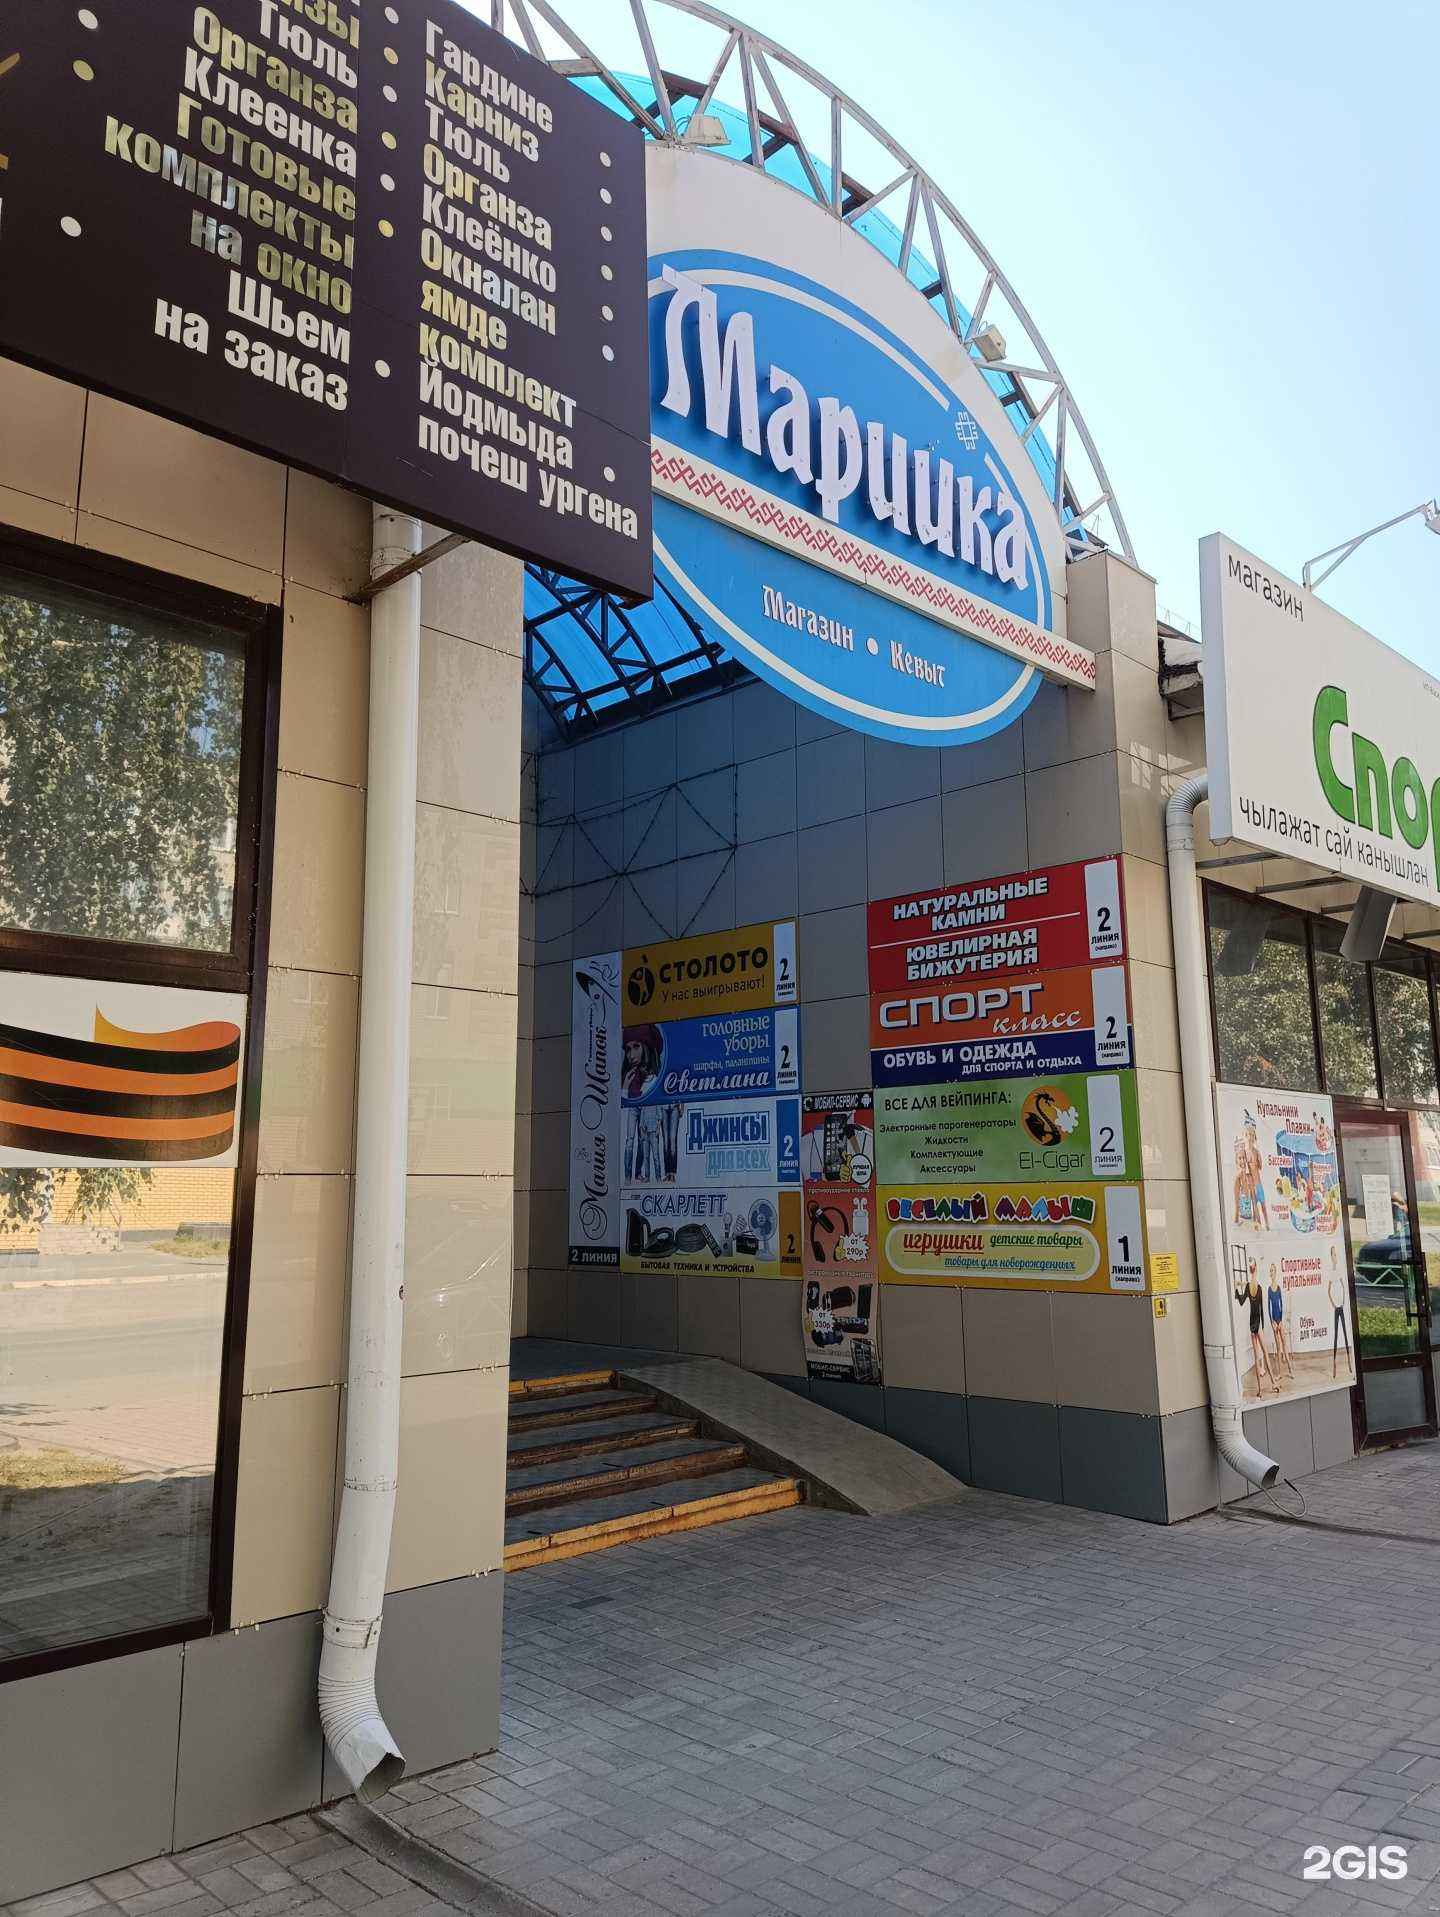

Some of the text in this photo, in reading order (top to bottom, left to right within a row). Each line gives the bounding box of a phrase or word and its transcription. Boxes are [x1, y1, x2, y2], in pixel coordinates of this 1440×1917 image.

[258, 0, 358, 88] Тюль
[194, 6, 358, 134] Органза
[426, 19, 552, 133] Гардине
[184, 46, 357, 178] Клеенка
[425, 60, 539, 162] Карниз
[425, 100, 510, 183] Тюль
[177, 93, 356, 220] Готовые
[104, 115, 355, 270] комплекты
[423, 143, 552, 250] Органза
[422, 183, 556, 293] Клеёнко
[190, 209, 352, 315] на окно
[421, 227, 556, 336] Окналан
[228, 270, 350, 364] Шьем
[421, 280, 507, 351] ямде
[154, 298, 348, 411] на заказ
[420, 322, 576, 428] комплект
[419, 357, 573, 470] Йодмыда
[418, 415, 638, 540] почеш ургена
[1228, 554, 1304, 622] магазин
[762, 584, 946, 688] Магазин Кевыт
[1239, 797, 1429, 889] чылажат сай канышлан
[893, 877, 1048, 920] НАТУРАЛЬНЫЕ
[931, 904, 1006, 931] КАМНИ
[1098, 907, 1111, 932] 2
[906, 927, 1038, 963] ЮВЕЛИРНАЯ
[1091, 932, 1120, 945] ЛИНИЯ
[659, 947, 768, 983] СТОЛОТО
[779, 957, 789, 981] 2
[907, 947, 1039, 981] БИЖУТЕРИЯ
[671, 989, 689, 1001] нас
[693, 975, 765, 999] выигрывают!
[880, 982, 1044, 1029] СПОРТ
[992, 1009, 1081, 1034] класс
[1106, 1016, 1118, 1039] 2
[780, 1045, 791, 1069] 2
[884, 1041, 1037, 1068] ОБУВЬ И ОДЕЖДА
[1098, 1040, 1126, 1052] ЛИНИЯ
[962, 1056, 1082, 1076] ДЛЯ СПОРТА И ОТДЫХА
[664, 1068, 770, 1095] Светлана
[885, 1091, 1012, 1112] ВСЕ ДЛЯ ВЕЙПИНГА:
[1257, 1100, 1299, 1118] Купальники
[880, 1118, 1017, 1133] Электронные парогенераторы
[783, 1136, 794, 1157] 2
[924, 1136, 969, 1146] Жидкости
[1099, 1126, 1115, 1153] 2
[910, 1149, 984, 1159] Комплектующие
[1094, 1155, 1122, 1163] ЛИНИЯ
[920, 1164, 976, 1174] Аксессуары
[642, 1195, 727, 1215] СКАРЛЕТТ
[571, 1250, 579, 1262] 2
[787, 1233, 796, 1254] 2
[903, 1231, 1083, 1255] игрушки детские товары
[1118, 1235, 1129, 1262] 1
[641, 1261, 754, 1273] БЫТОВАЯ ТЕХНИКА И УСТРОЙСТВА
[944, 1256, 1075, 1271] товары для новорожденных
[1111, 1265, 1141, 1275] ЛИНИЯ
[1281, 1257, 1321, 1273] Спортивные
[1282, 1275, 1322, 1291] купальники
[1299, 1317, 1315, 1328] Обувь
